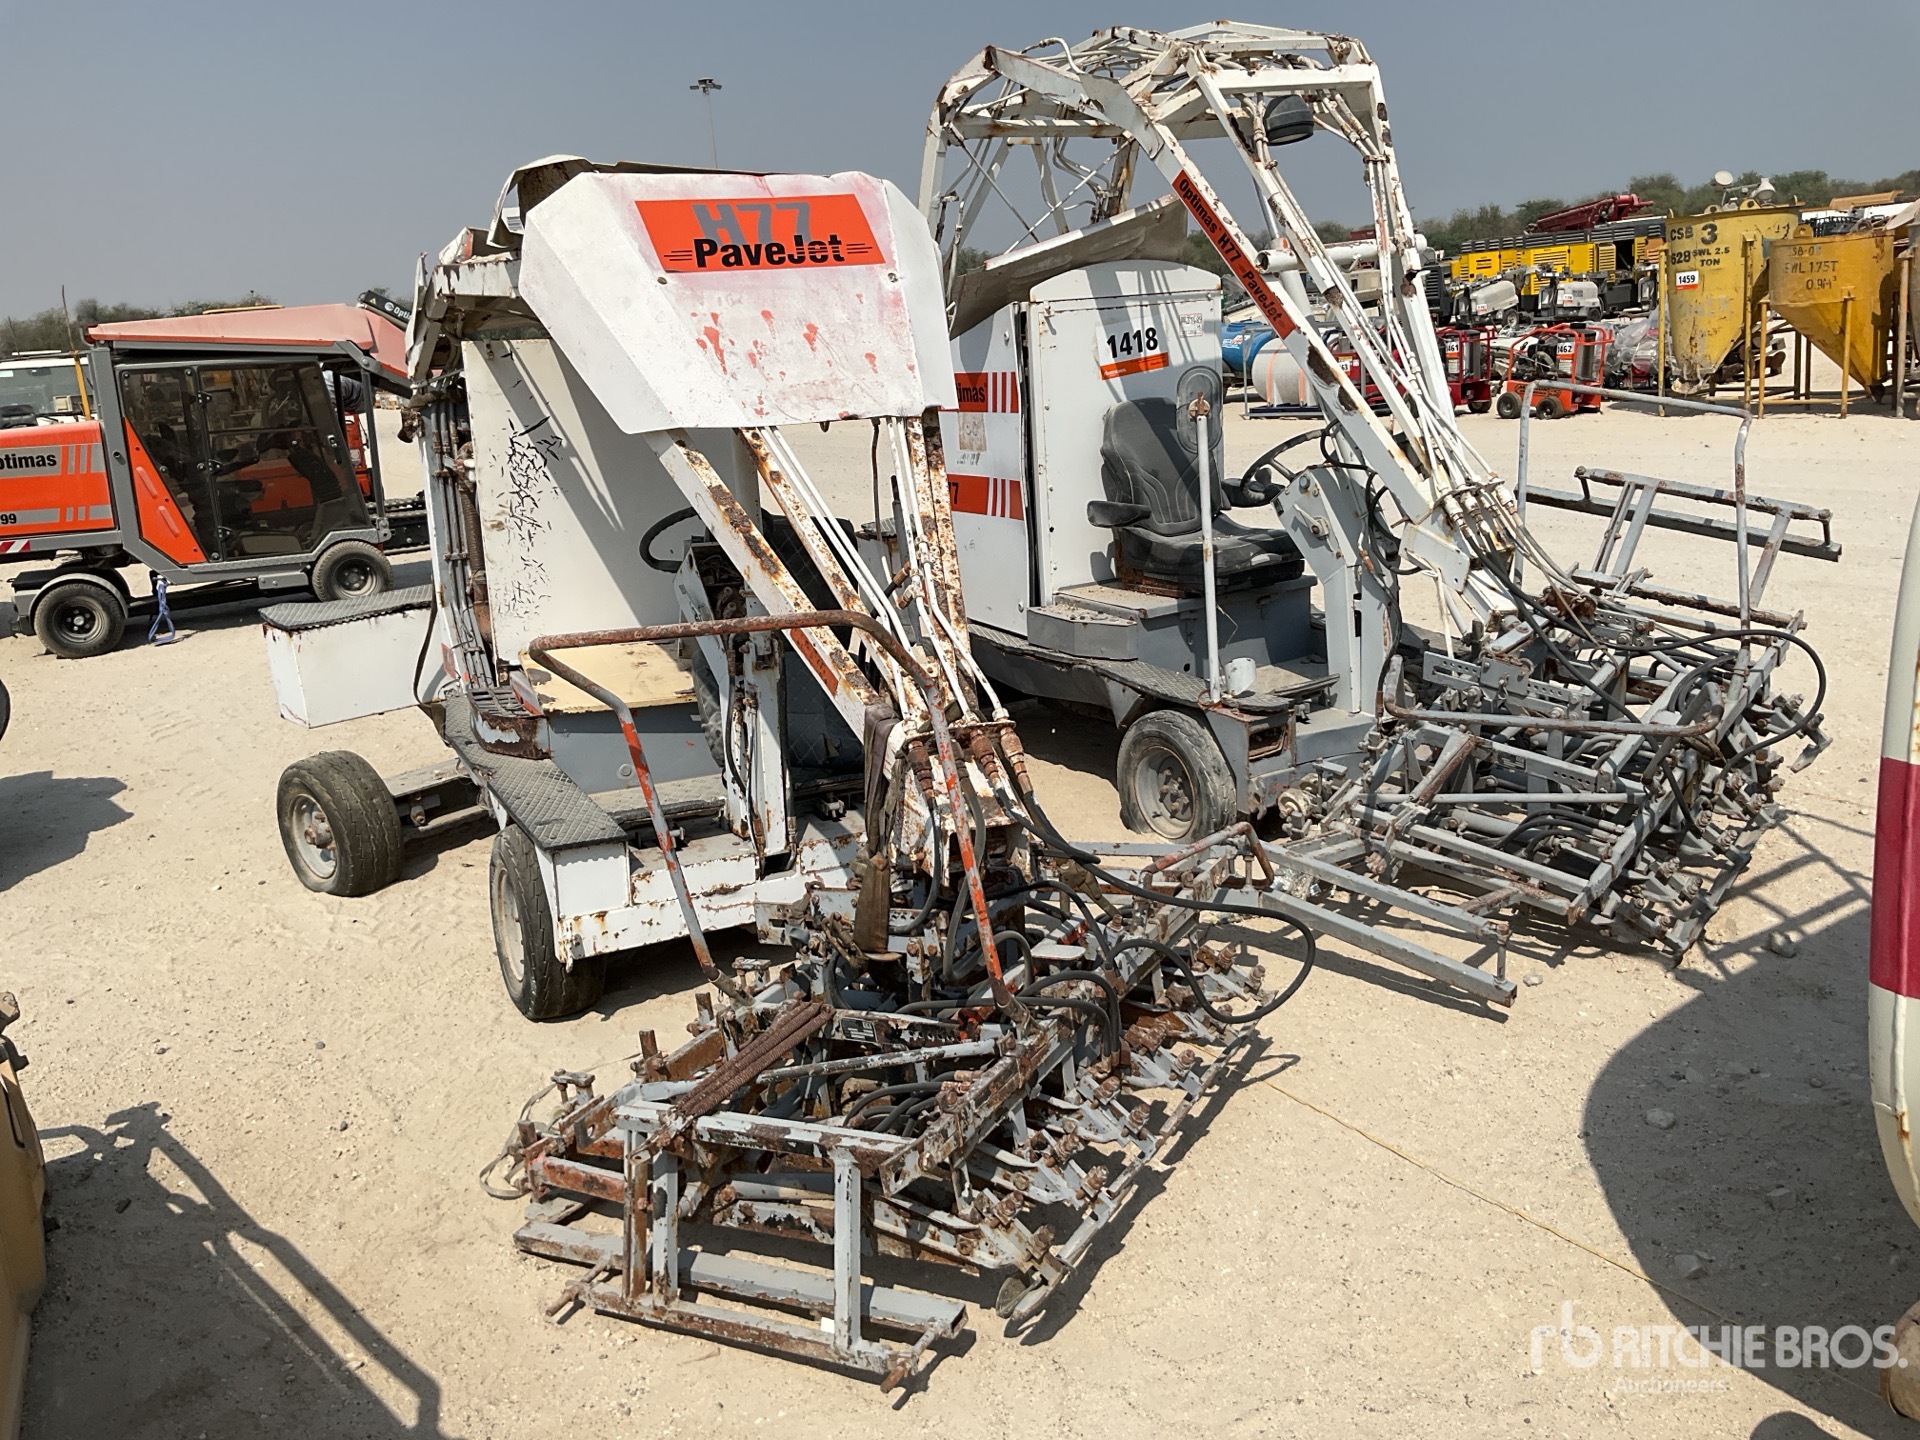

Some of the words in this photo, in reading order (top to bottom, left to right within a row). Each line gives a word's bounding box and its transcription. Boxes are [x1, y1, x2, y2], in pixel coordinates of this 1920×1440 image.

[691, 202, 812, 246] H77
[1670, 225, 1694, 241] CSB
[1700, 222, 1718, 245] 3
[693, 234, 845, 268] PaveJet
[1178, 178, 1218, 234] Optimas
[1217, 232, 1242, 263] H77
[1242, 271, 1283, 321] PaveJet
[1692, 248, 1712, 257] SWL
[1714, 246, 1730, 255] 2.5
[1670, 250, 1691, 266] 628
[1700, 258, 1721, 267] TON
[1678, 274, 1696, 285] 1459
[393, 306, 411, 319] Opti
[1106, 327, 1158, 358] 1418
[1557, 344, 1573, 354] 1462
[1340, 363, 1349, 372] 63
[0, 513, 17, 525] 99
